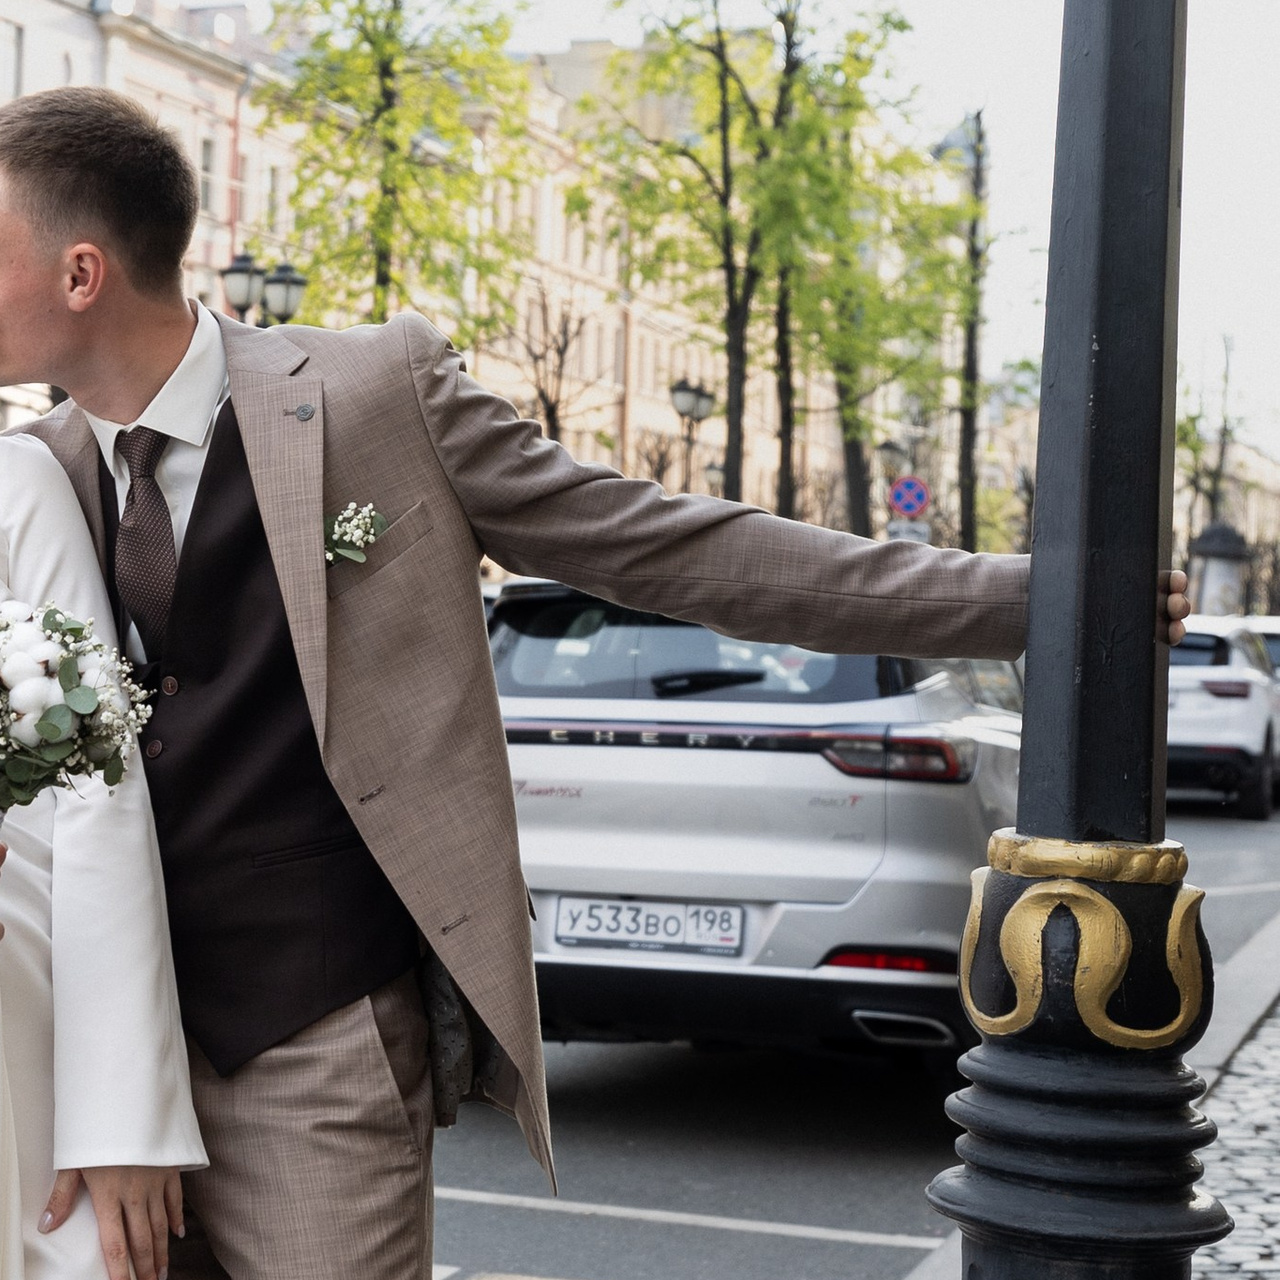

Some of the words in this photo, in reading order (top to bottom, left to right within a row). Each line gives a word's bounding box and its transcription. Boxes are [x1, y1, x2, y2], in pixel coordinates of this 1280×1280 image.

[549, 729, 755, 748] CHERY
[569, 904, 682, 937] У533ВО
[689, 908, 733, 933] 198
